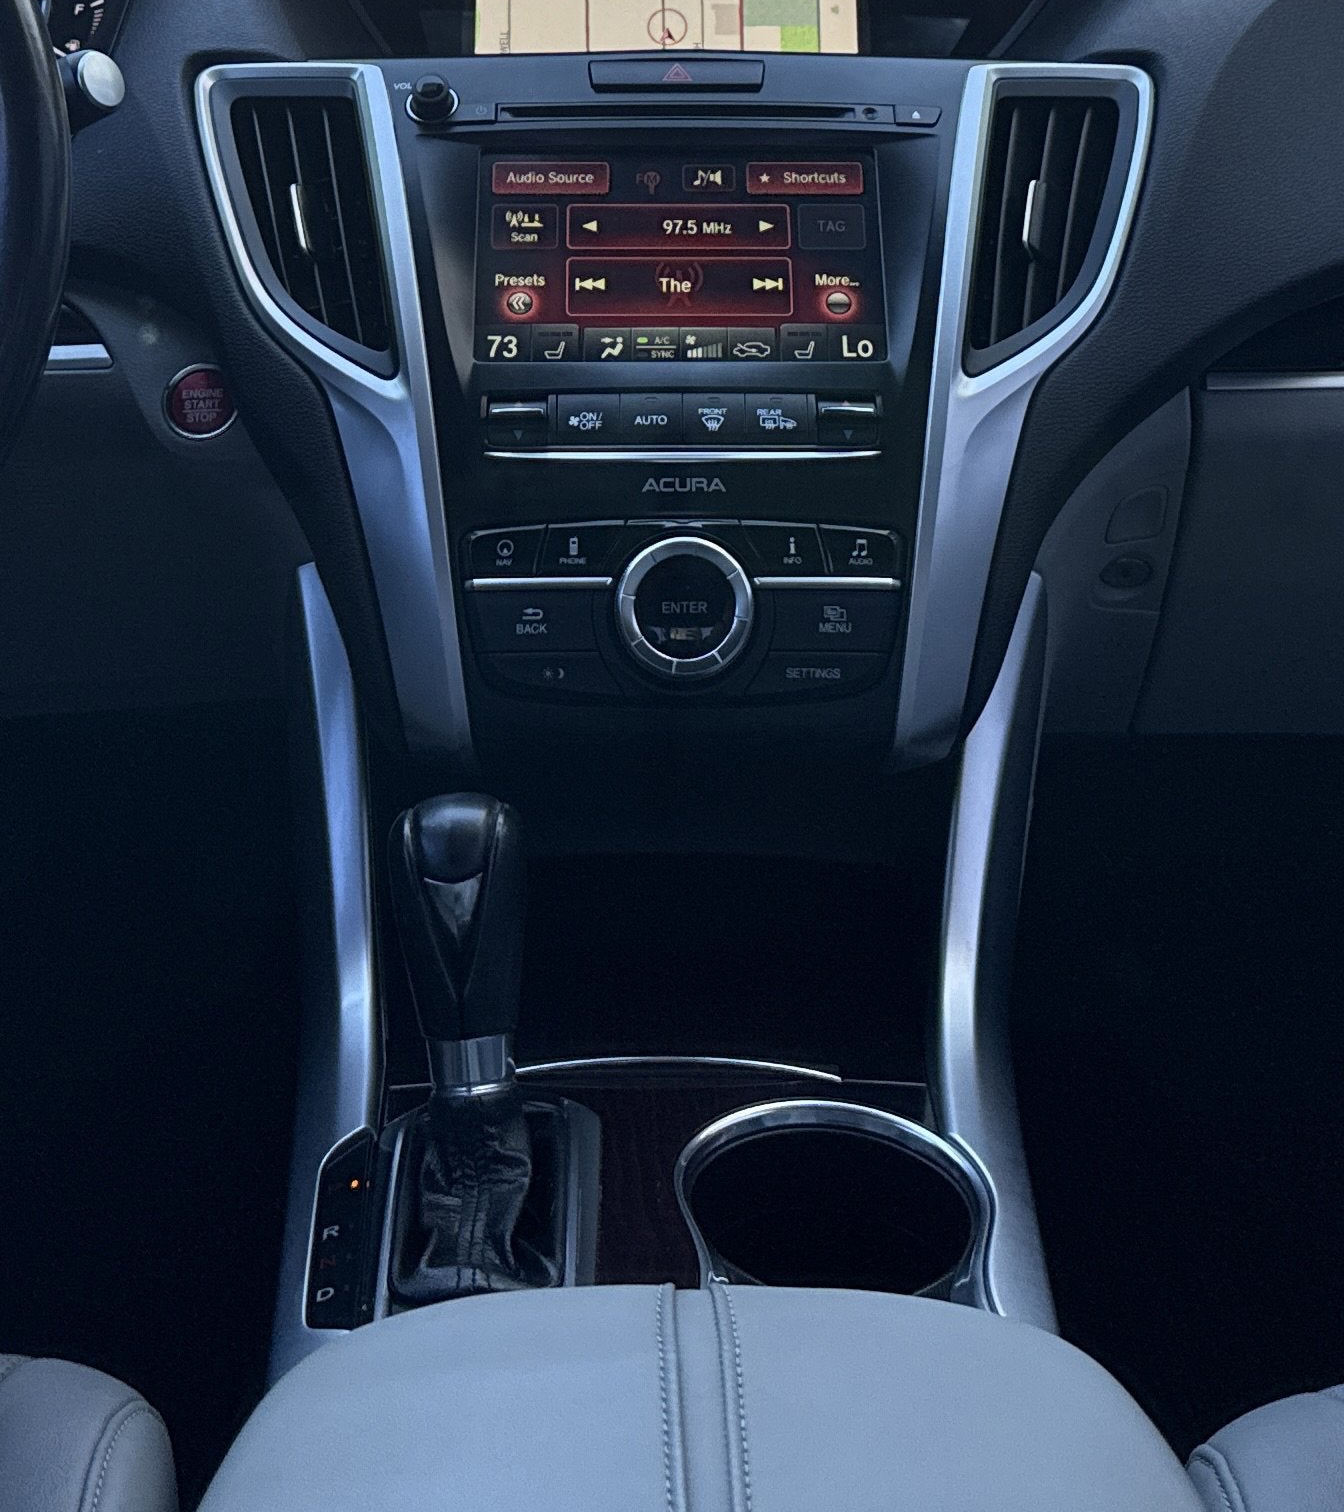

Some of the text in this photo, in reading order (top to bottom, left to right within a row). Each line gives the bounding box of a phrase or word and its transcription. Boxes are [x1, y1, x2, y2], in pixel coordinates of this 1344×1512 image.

[73, 3, 86, 16] F
[506, 170, 595, 185] Audio Source
[782, 170, 847, 185] Shortcuts
[662, 219, 733, 235] 97.5 MHz
[817, 220, 846, 233] TAG
[510, 231, 539, 244] Scan
[494, 273, 546, 287] Presets
[659, 277, 692, 294] The
[486, 334, 518, 359] 73
[654, 335, 671, 346] A/C
[841, 334, 874, 359] Lo
[651, 348, 675, 359] SYNC
[181, 388, 225, 400] ENGINE
[183, 399, 221, 411] START
[698, 407, 728, 416] FRONT
[186, 411, 218, 424] STOP
[579, 411, 603, 422] ON/
[756, 408, 782, 416] REAR
[580, 420, 603, 430] OFF
[634, 414, 668, 426] AUTO
[641, 477, 727, 493] ACURA
[495, 558, 513, 566] NAV
[559, 557, 587, 565] PHONE
[783, 556, 803, 565] INFO
[848, 557, 874, 566] AUDIO
[661, 600, 708, 614] ENTER
[515, 622, 548, 635] BACK
[818, 621, 852, 634] MENU
[785, 667, 841, 680] SETTINGS
[321, 1224, 340, 1241] R
[316, 1287, 335, 1303] D
